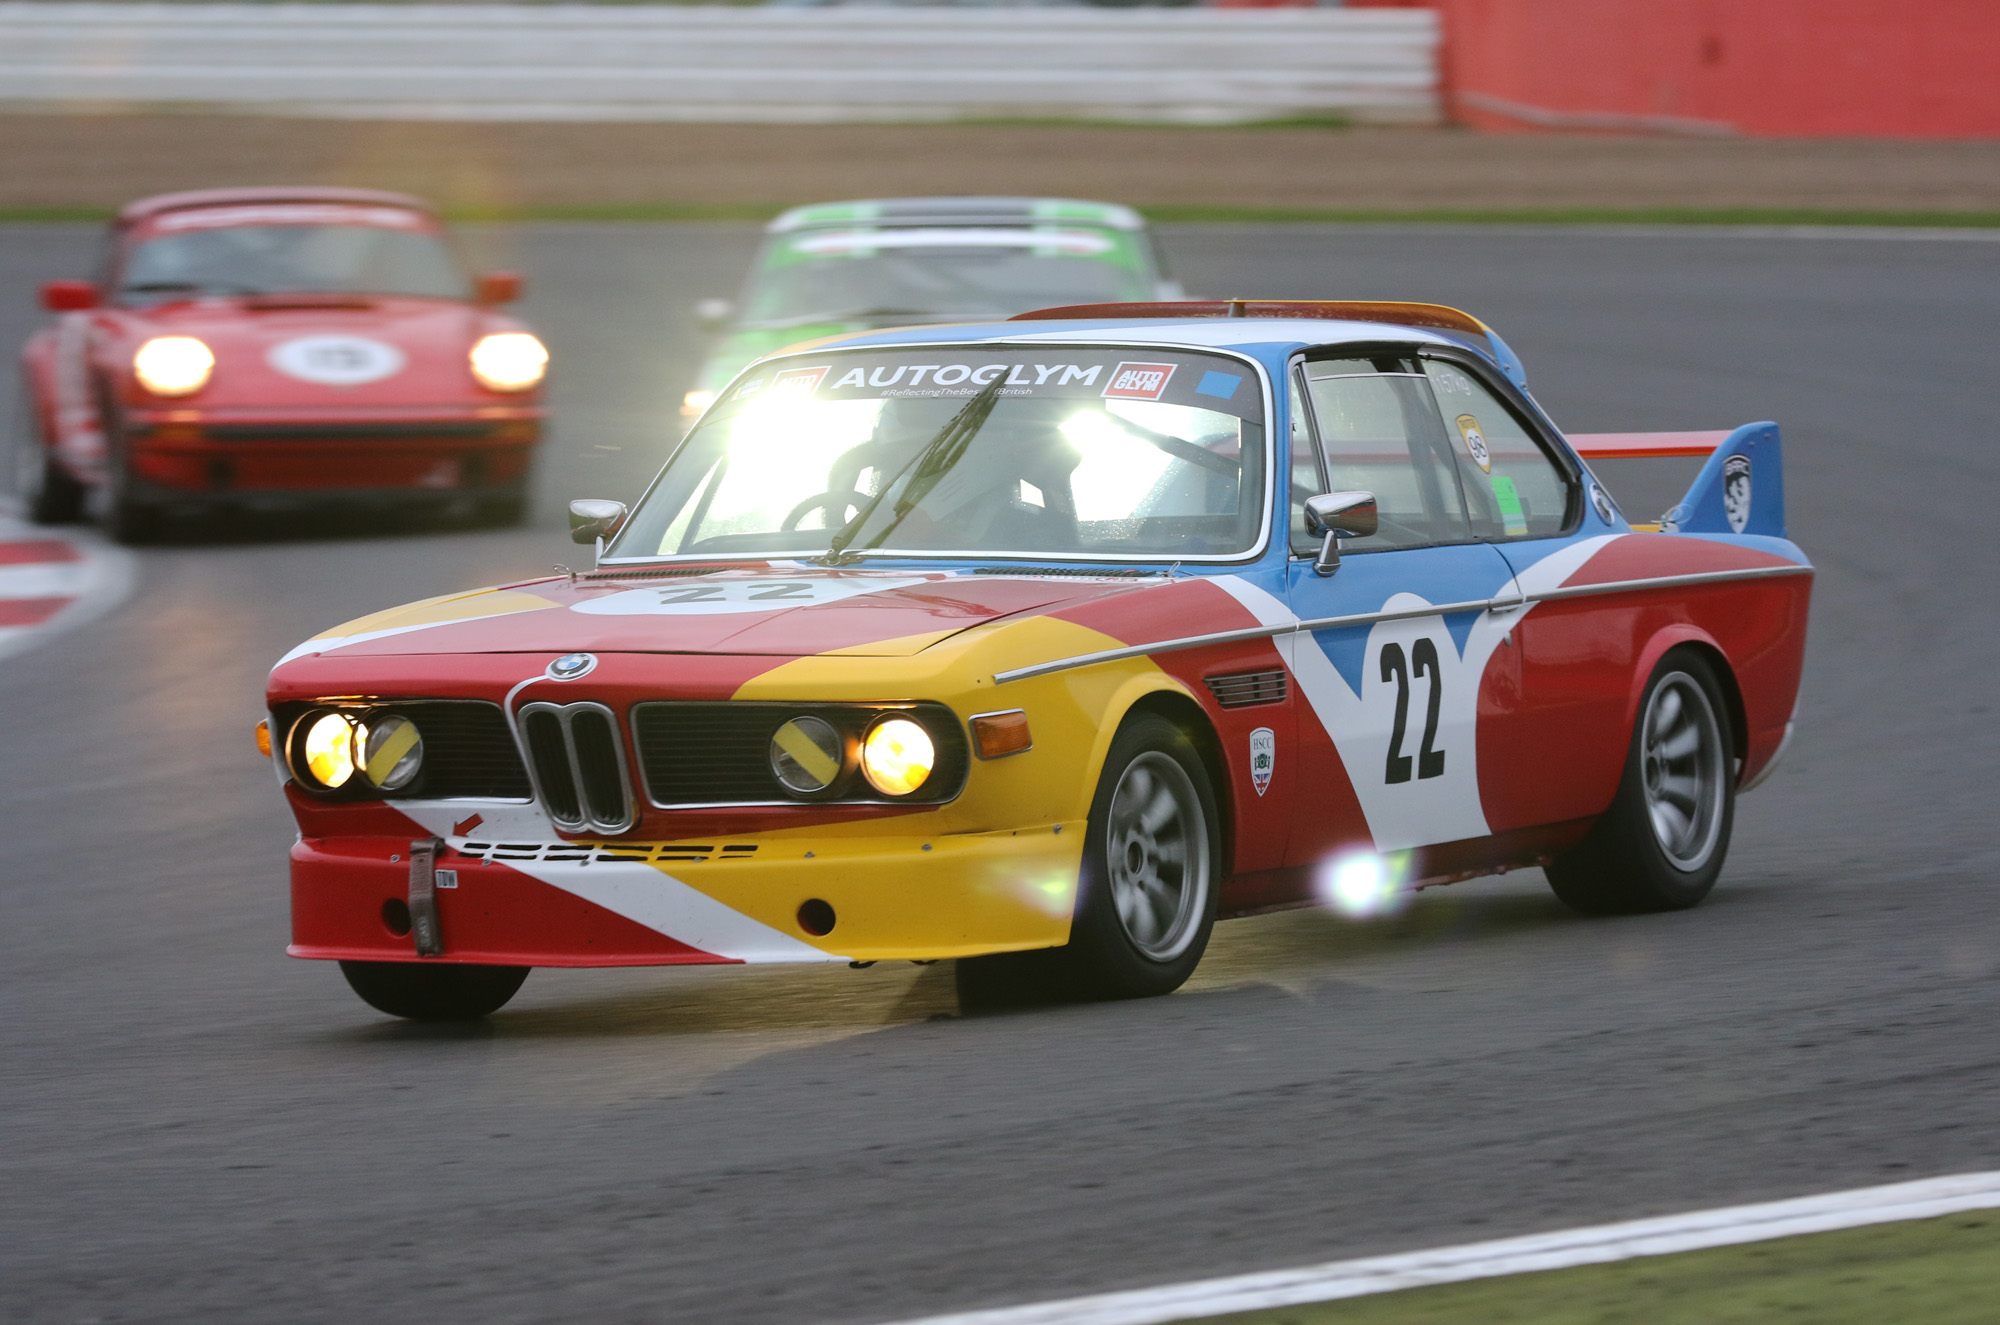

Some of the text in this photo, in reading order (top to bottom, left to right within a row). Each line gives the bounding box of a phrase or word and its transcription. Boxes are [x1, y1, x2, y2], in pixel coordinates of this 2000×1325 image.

[830, 364, 1103, 389] AUTOGLYM
[1113, 379, 1160, 391] GLYM
[1118, 370, 1164, 382] AUTO
[1468, 436, 1487, 459] 98
[658, 582, 814, 605] 22
[1379, 637, 1445, 785] 22
[1253, 737, 1272, 750] HSCC
